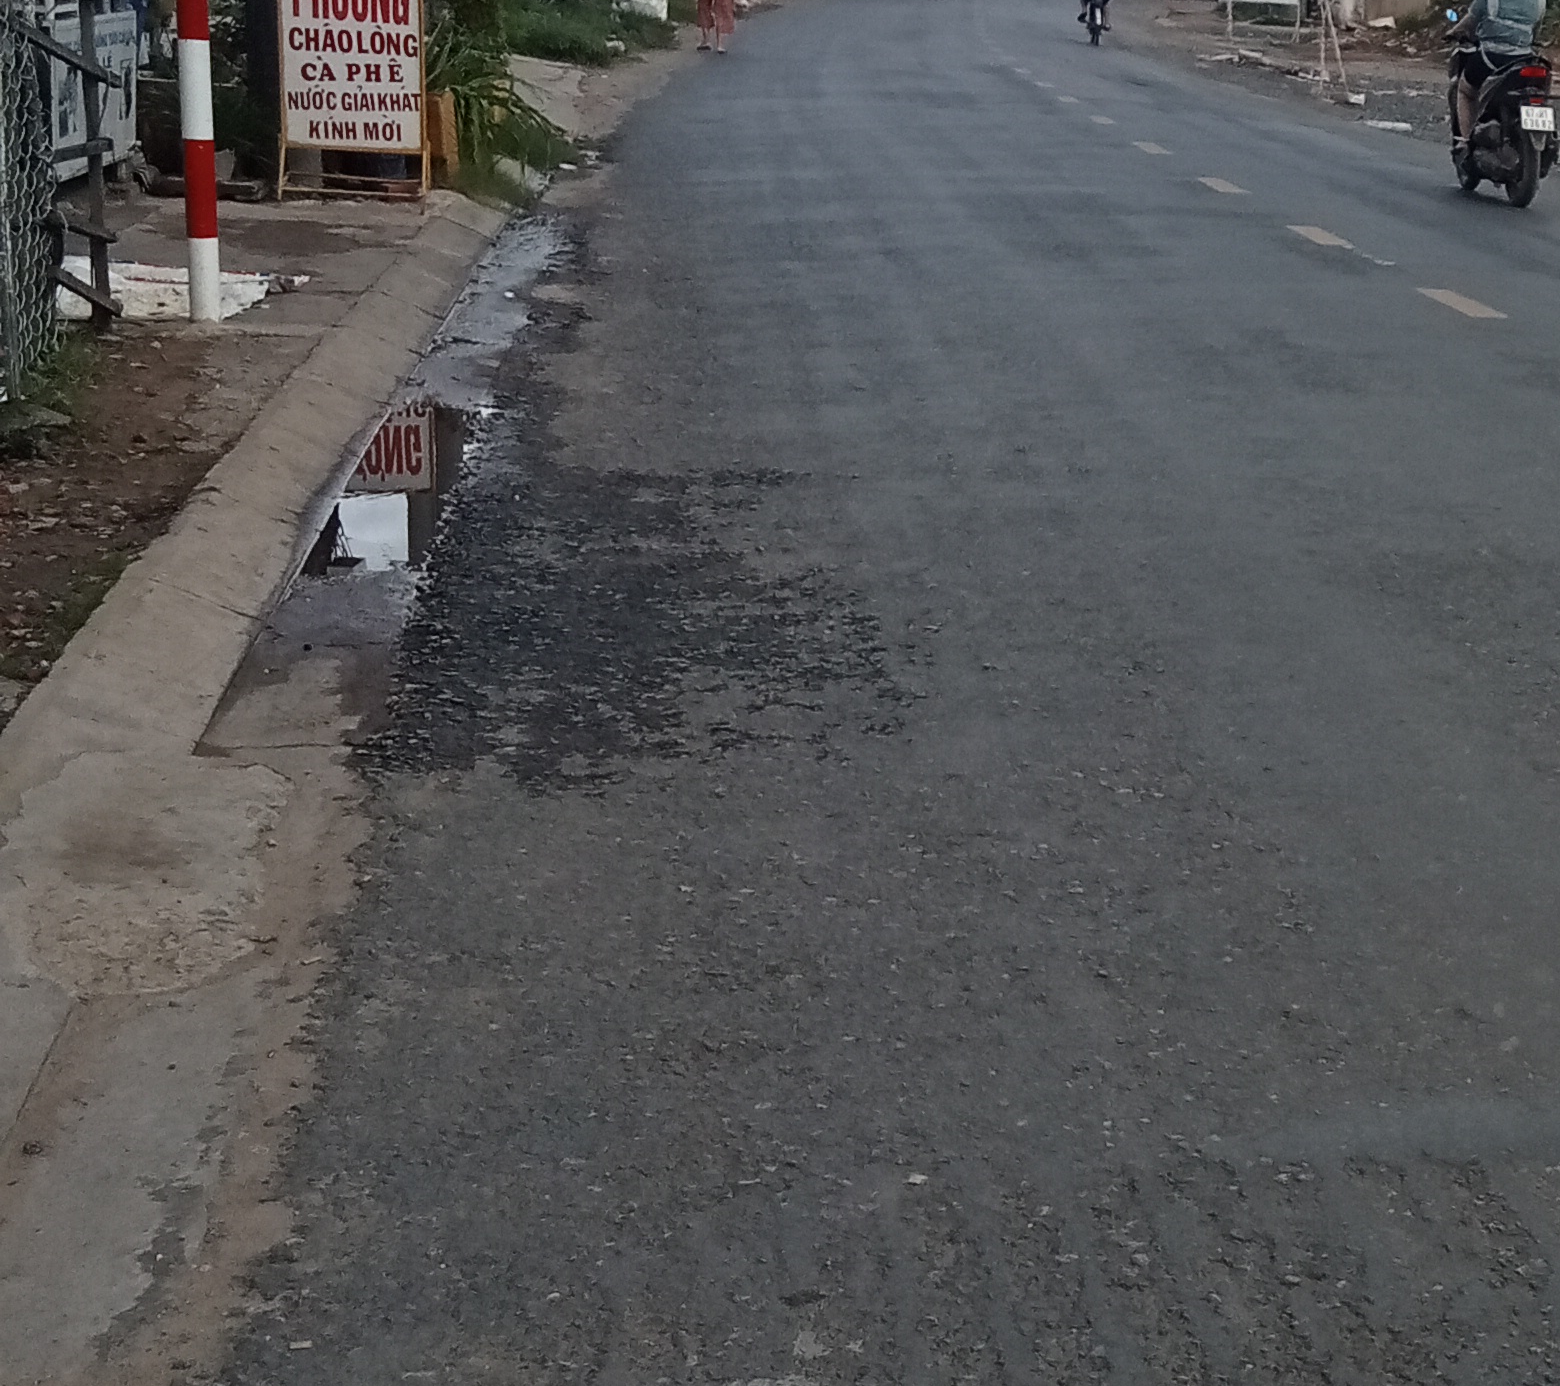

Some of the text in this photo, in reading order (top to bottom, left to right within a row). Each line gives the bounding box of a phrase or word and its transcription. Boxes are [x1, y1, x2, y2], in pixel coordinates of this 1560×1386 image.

[288, 23, 418, 59] CHÁO LÒNG
[300, 55, 404, 84] CÀ PHÊ
[287, 84, 421, 112] NƯỚC GIẢI KHÁT
[308, 114, 402, 142] KÍNH MỜI
